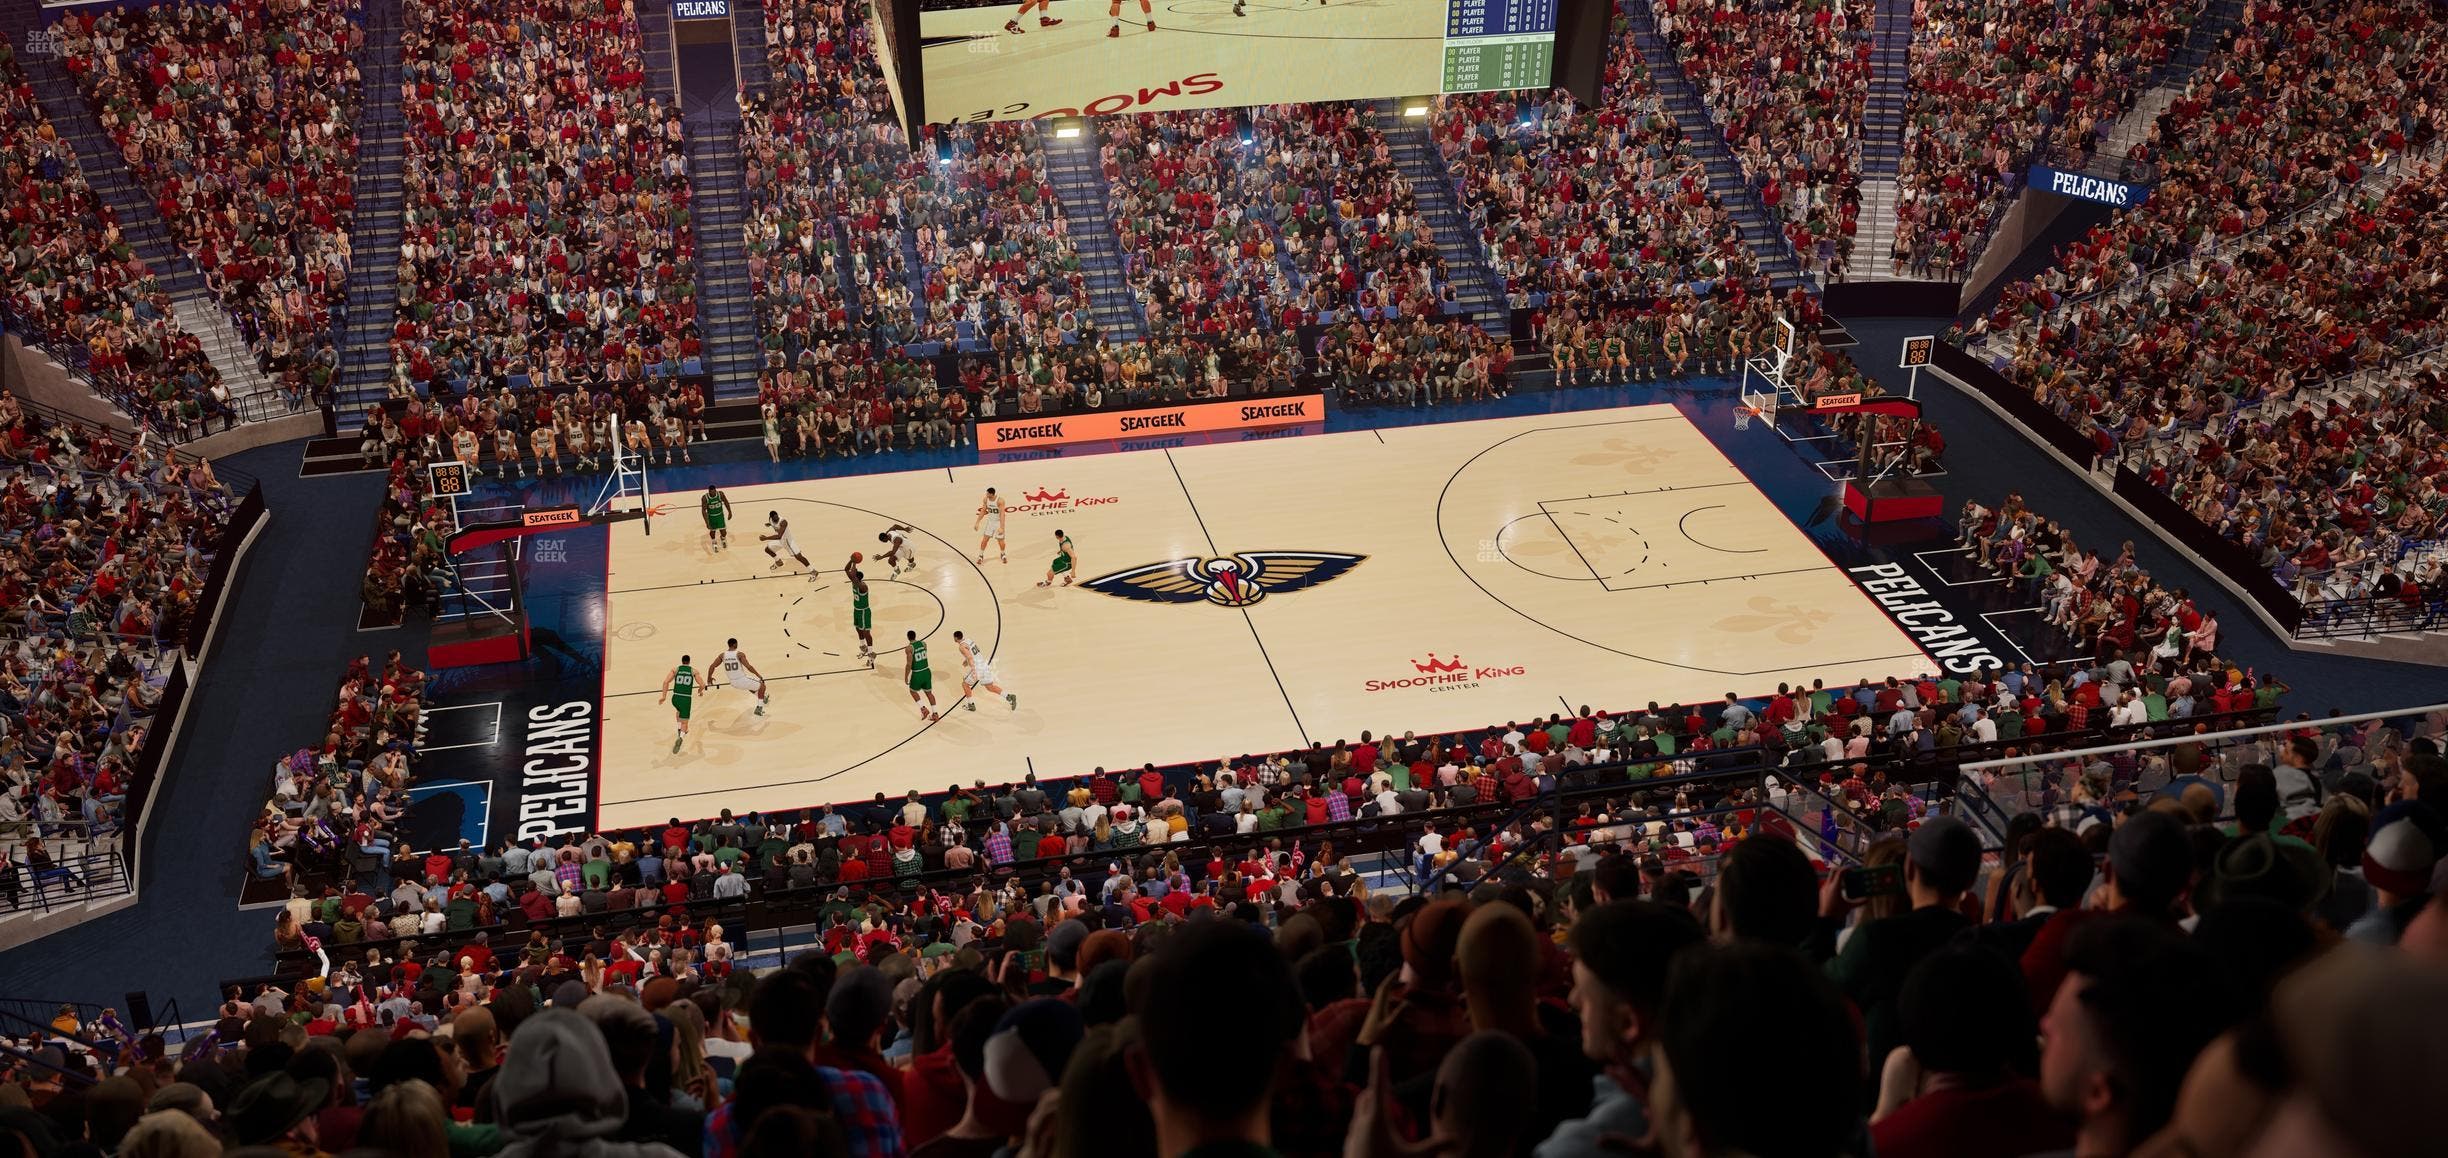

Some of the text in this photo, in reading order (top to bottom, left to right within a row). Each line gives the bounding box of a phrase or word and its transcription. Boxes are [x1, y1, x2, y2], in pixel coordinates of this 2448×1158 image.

[676, 1, 726, 16] PELICANS
[2052, 172, 2128, 205] PELICANS
[1821, 396, 1856, 406] SEATGEEK
[997, 402, 1305, 442] SEATGEEK SEATGEEK SEATGEEK
[529, 512, 573, 523] SEATGEEK
[1848, 562, 2003, 673] PELICANS
[725, 662, 738, 671] 00
[675, 675, 692, 685] 00
[1365, 672, 1469, 691] SMOOTHIE
[1429, 682, 1480, 693] CENTER
[518, 701, 592, 842] PELICANS
